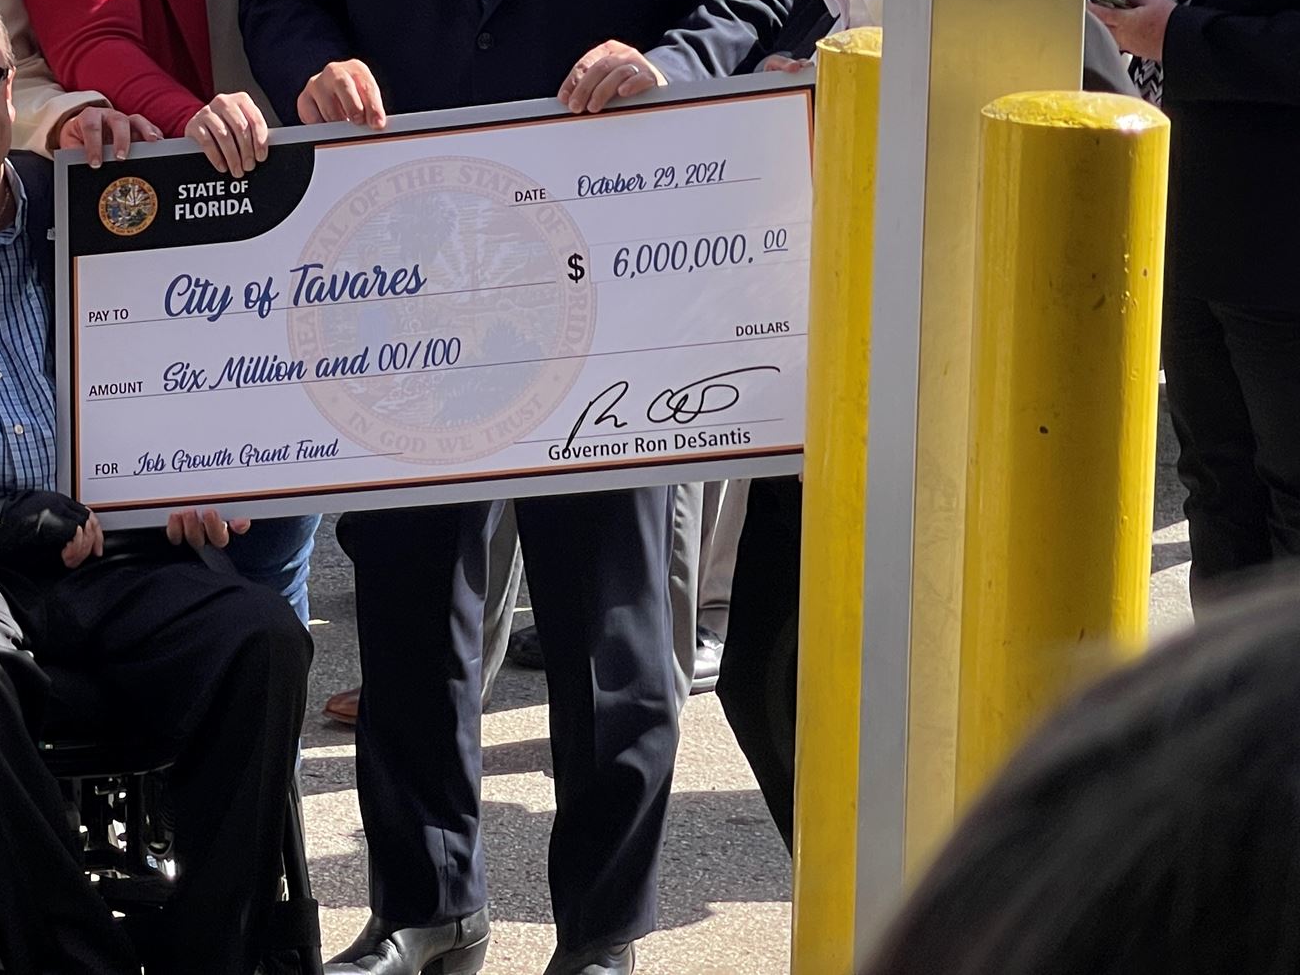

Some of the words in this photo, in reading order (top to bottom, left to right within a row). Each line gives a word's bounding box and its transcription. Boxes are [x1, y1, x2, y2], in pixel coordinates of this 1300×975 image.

[178, 181, 225, 199] STATE
[230, 180, 249, 195] OF
[515, 188, 547, 203] DATE
[577, 173, 648, 198] October
[653, 165, 680, 189] 29,
[685, 159, 727, 186] 2021
[175, 198, 254, 220] FLORIDA
[567, 253, 586, 283] $
[763, 228, 789, 252] 00
[88, 310, 109, 323] PAY
[113, 308, 129, 320] TO
[164, 274, 234, 322] City
[244, 276, 280, 319] of
[289, 263, 428, 306] Tavares
[735, 321, 790, 337] DOLLARS
[88, 381, 143, 397] AMOUNT
[163, 360, 207, 394] Six
[207, 354, 307, 390] Million
[315, 346, 370, 379] and
[378, 337, 461, 372] 00/100
[94, 462, 119, 476] FOR
[133, 450, 166, 476] Job
[171, 447, 234, 473] Growth
[239, 443, 290, 467] Grant
[296, 438, 340, 460] Fund
[548, 438, 629, 461] Governor
[634, 435, 668, 453] Ron
[674, 427, 751, 451] DeSantis
